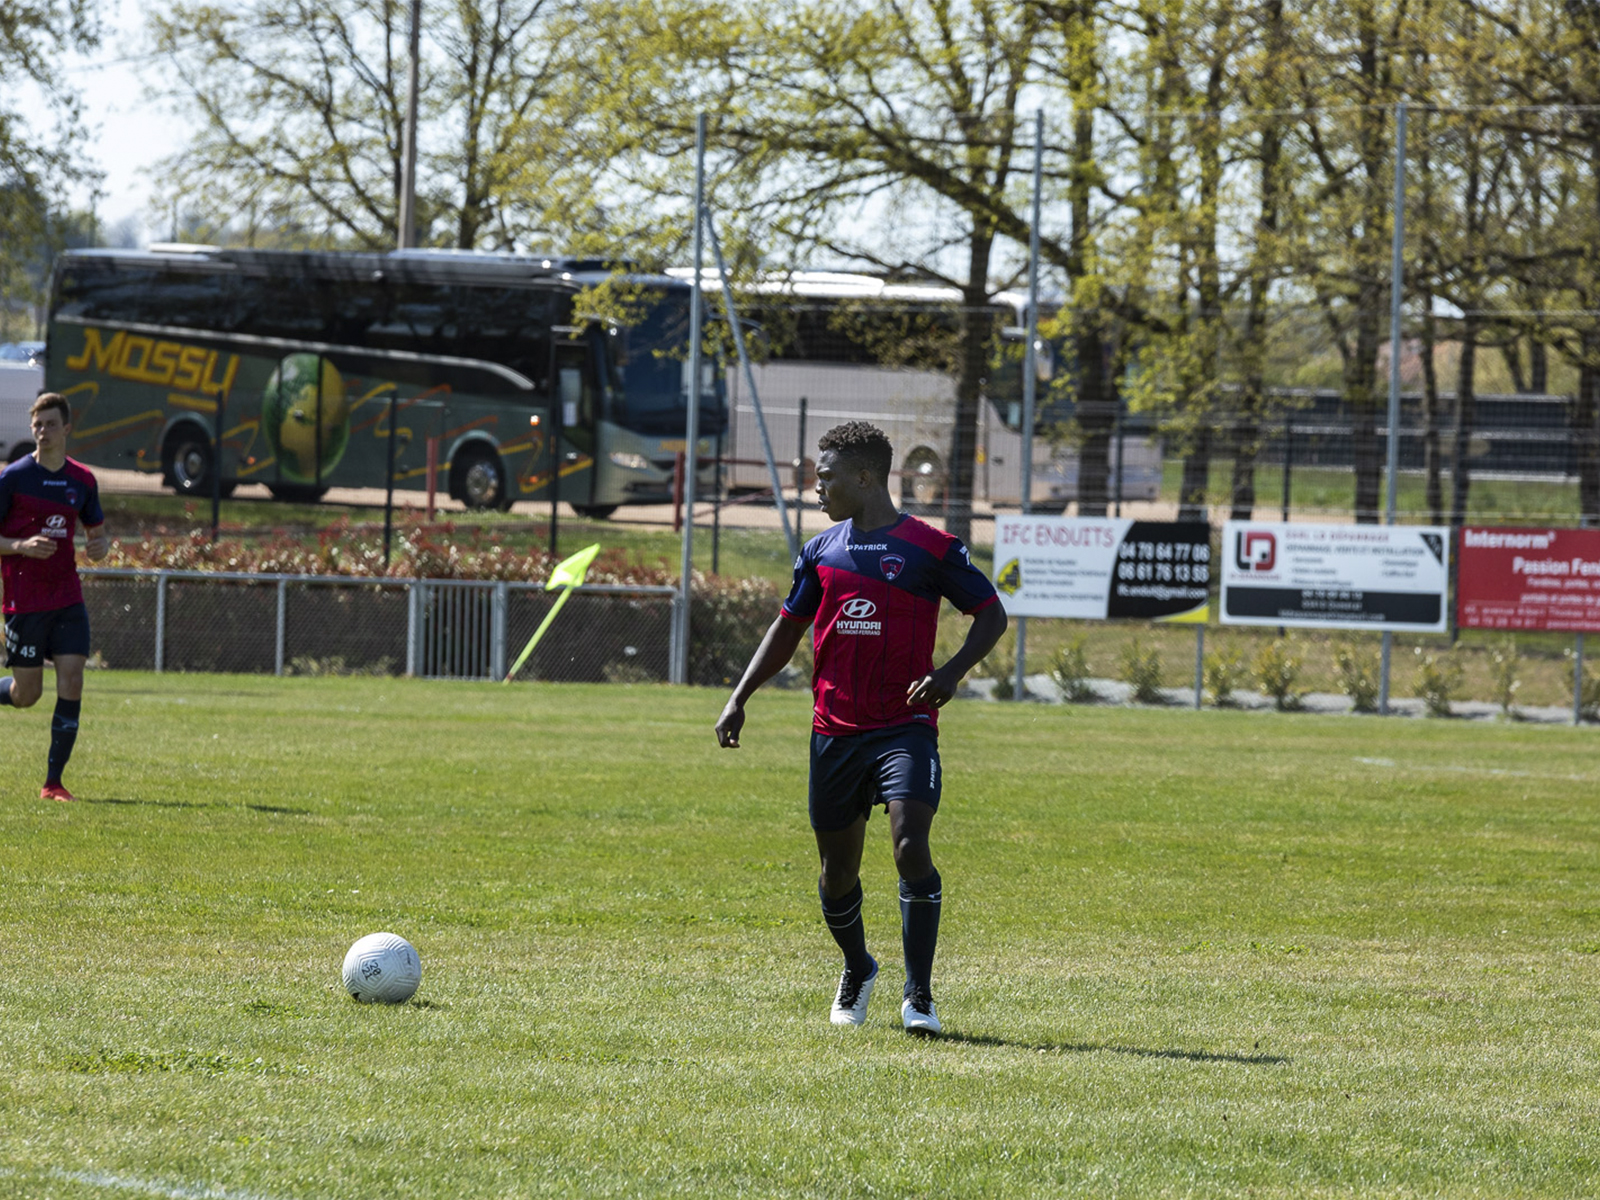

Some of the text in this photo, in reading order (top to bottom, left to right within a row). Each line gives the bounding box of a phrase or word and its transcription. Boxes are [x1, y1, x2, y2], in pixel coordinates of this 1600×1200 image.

[1002, 524, 1115, 548] IFC ENDUITS
[853, 543, 888, 551] PATRICK
[1174, 543, 1192, 562] 77
[1512, 556, 1570, 575] Passion
[836, 621, 882, 630] HYUNDAI
[20, 646, 36, 658] 45
